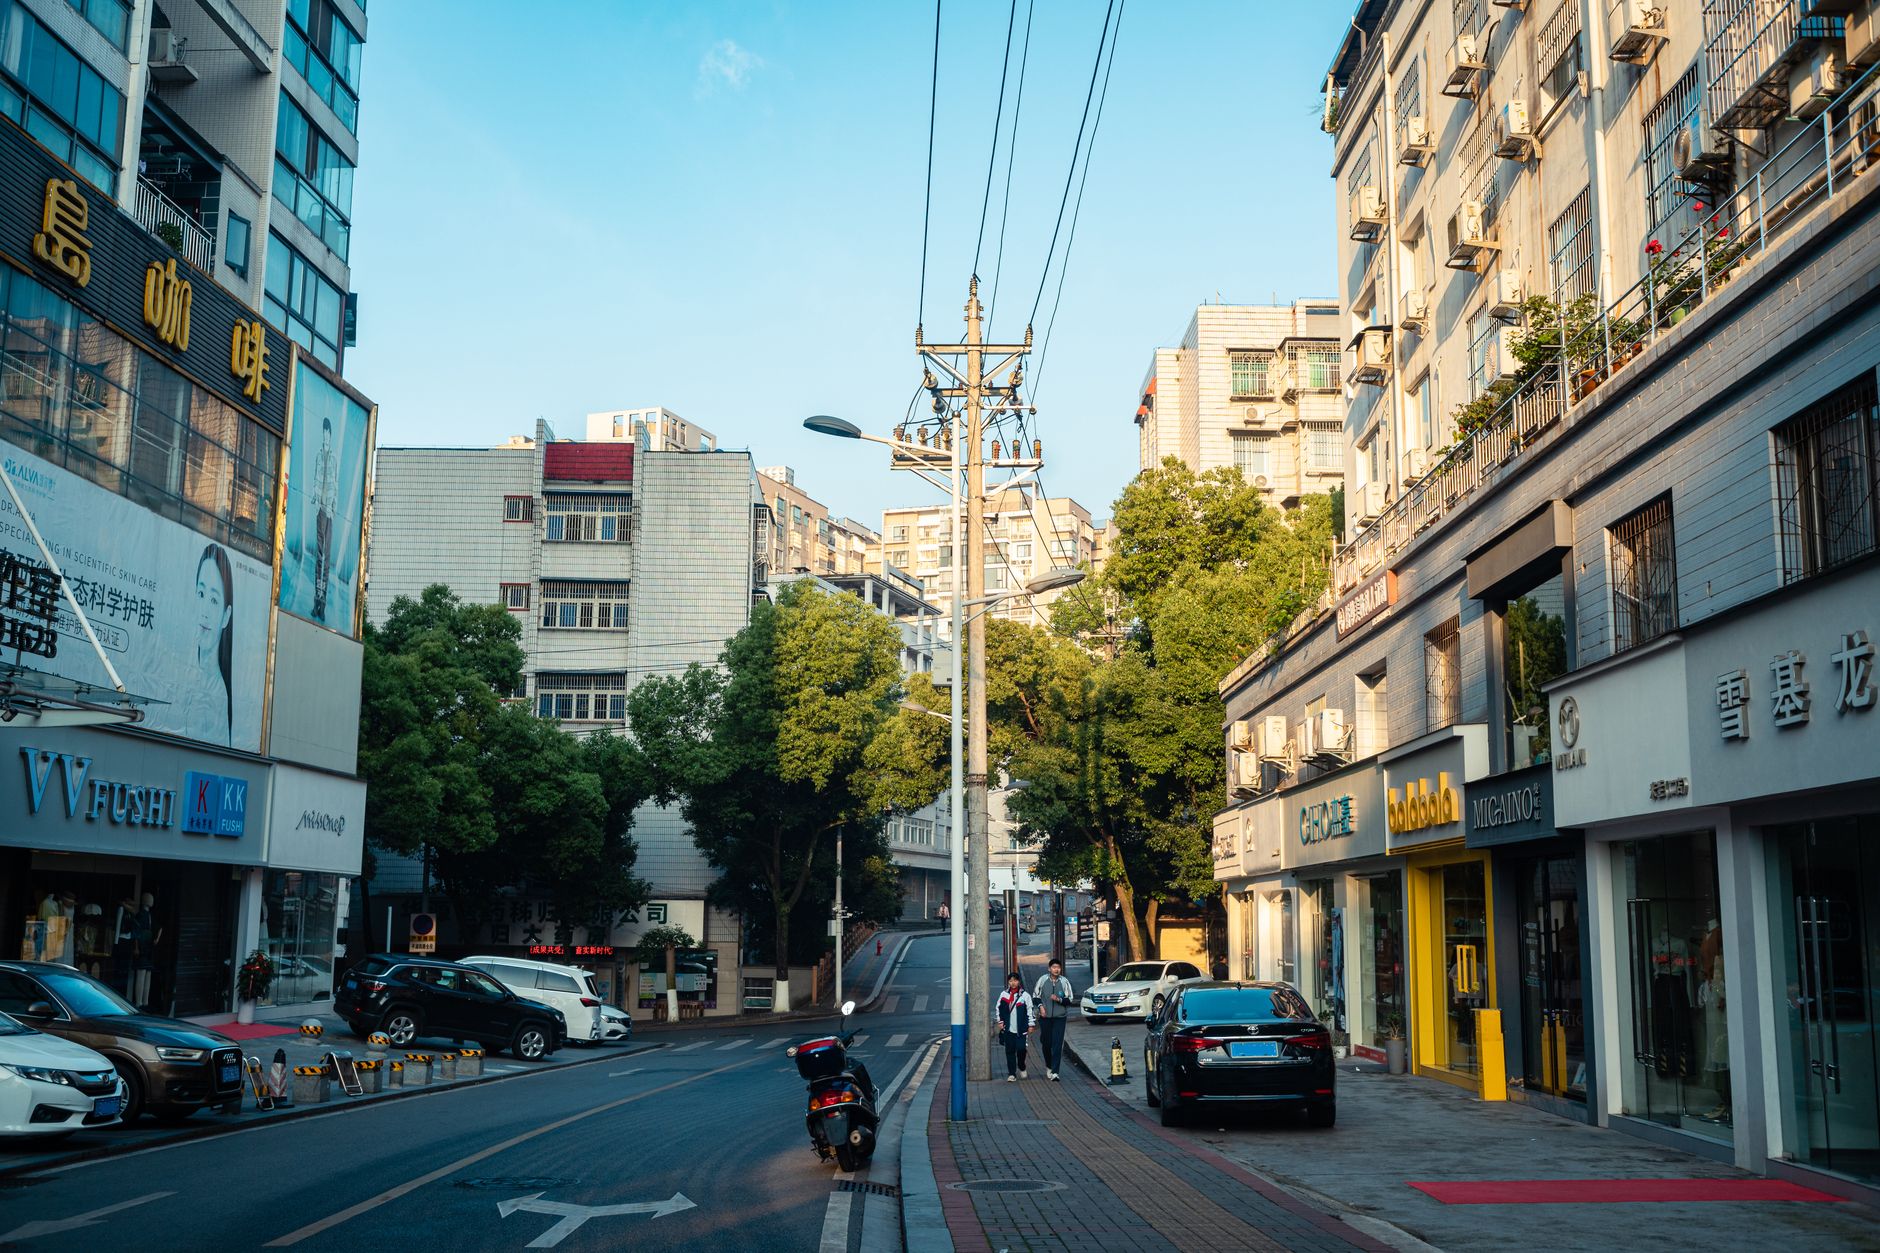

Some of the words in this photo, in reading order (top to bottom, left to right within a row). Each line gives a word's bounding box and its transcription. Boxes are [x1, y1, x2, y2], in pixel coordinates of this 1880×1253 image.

[1, 499, 36, 524] DR.AA
[0, 521, 60, 555] SPECIALING
[62, 547, 72, 559] IN
[73, 551, 117, 577] SCIENTIFIC
[118, 568, 137, 585] SKIN
[138, 576, 158, 592] CARE
[0, 613, 57, 658] 1628
[1715, 630, 1878, 741] 雪基龙
[197, 778, 210, 814] K
[1473, 787, 1533, 830] MIGAINO
[221, 818, 244, 833] FUSHI
